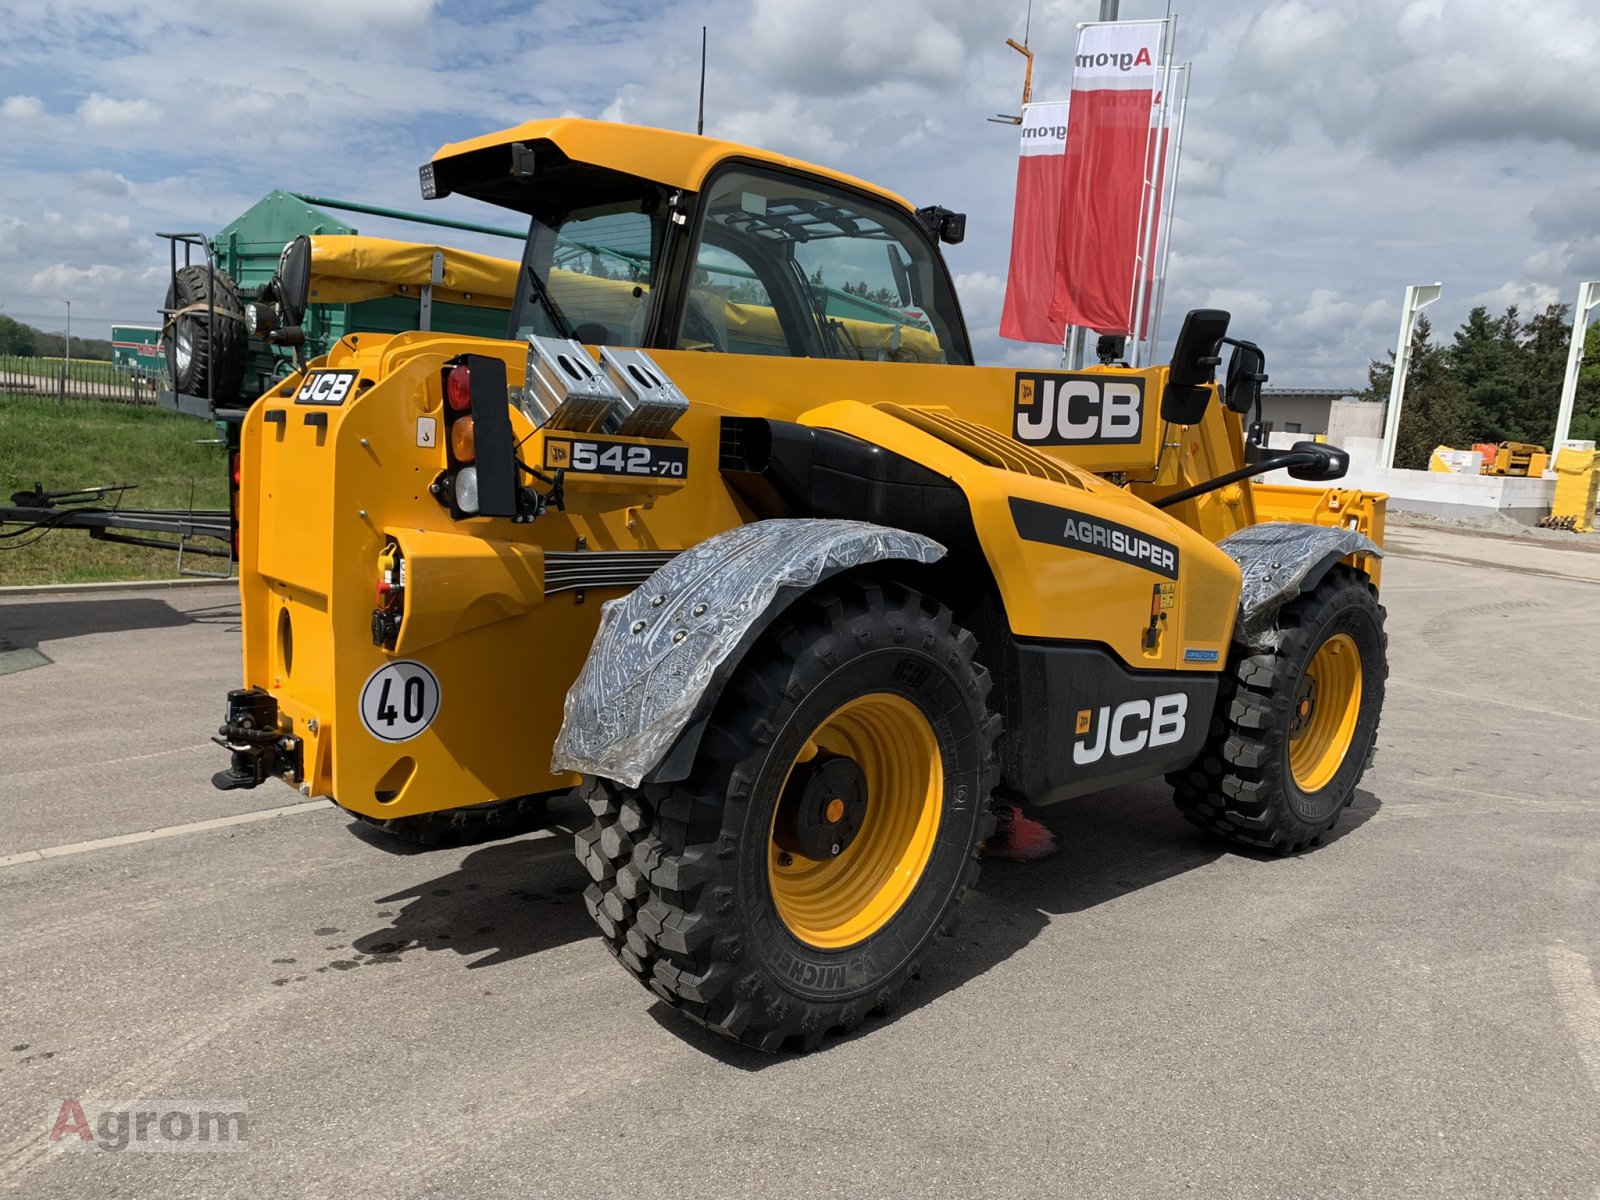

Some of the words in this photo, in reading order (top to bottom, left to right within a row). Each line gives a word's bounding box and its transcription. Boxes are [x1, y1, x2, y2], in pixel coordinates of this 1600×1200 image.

[299, 373, 353, 401] JCB
[1017, 380, 1140, 440] JCB
[1063, 518, 1174, 571] AGRISUPER
[377, 676, 424, 726] 40
[1073, 692, 1188, 765] JCB
